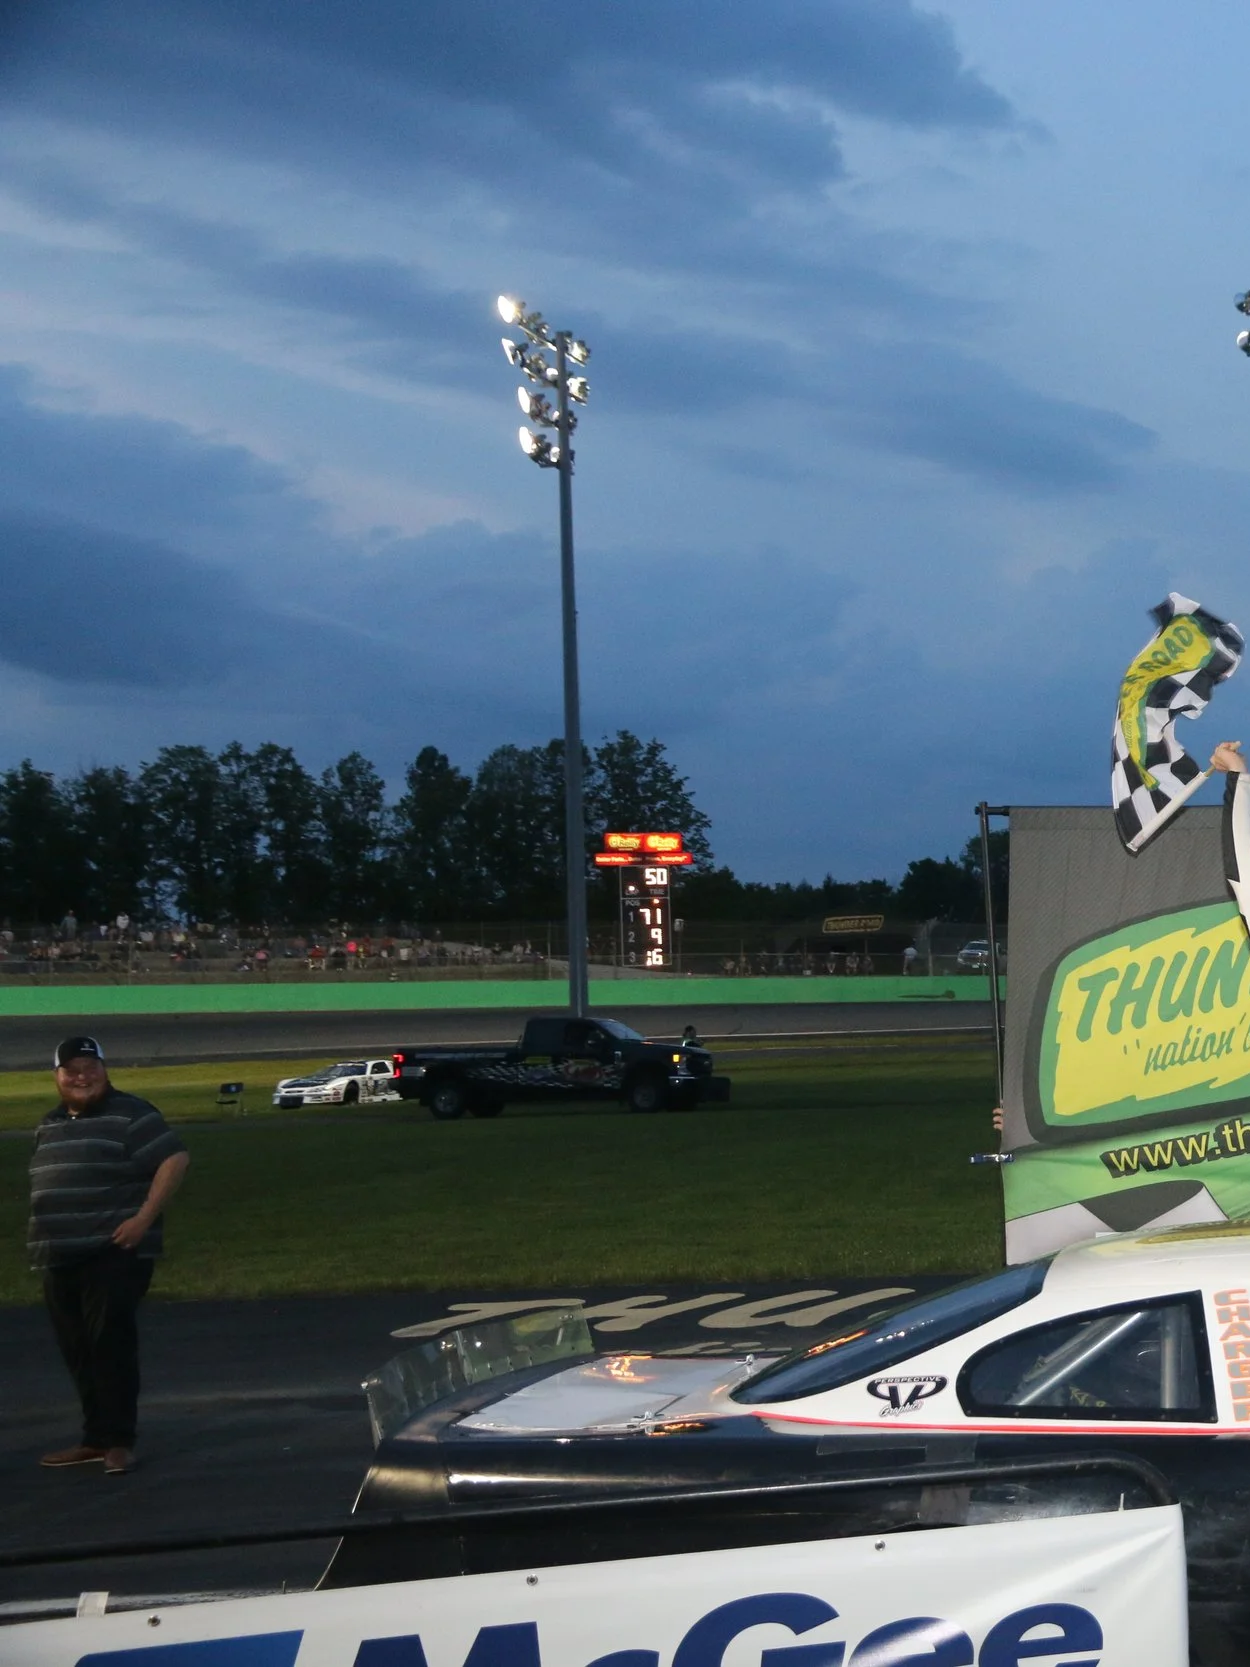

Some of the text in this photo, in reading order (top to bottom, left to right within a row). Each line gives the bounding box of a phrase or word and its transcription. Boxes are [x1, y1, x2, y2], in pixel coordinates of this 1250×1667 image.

[645, 868, 667, 885] 50
[639, 908, 662, 925] 71
[651, 928, 663, 945] 9
[873, 1376, 942, 1385] PERSPECTIVE
